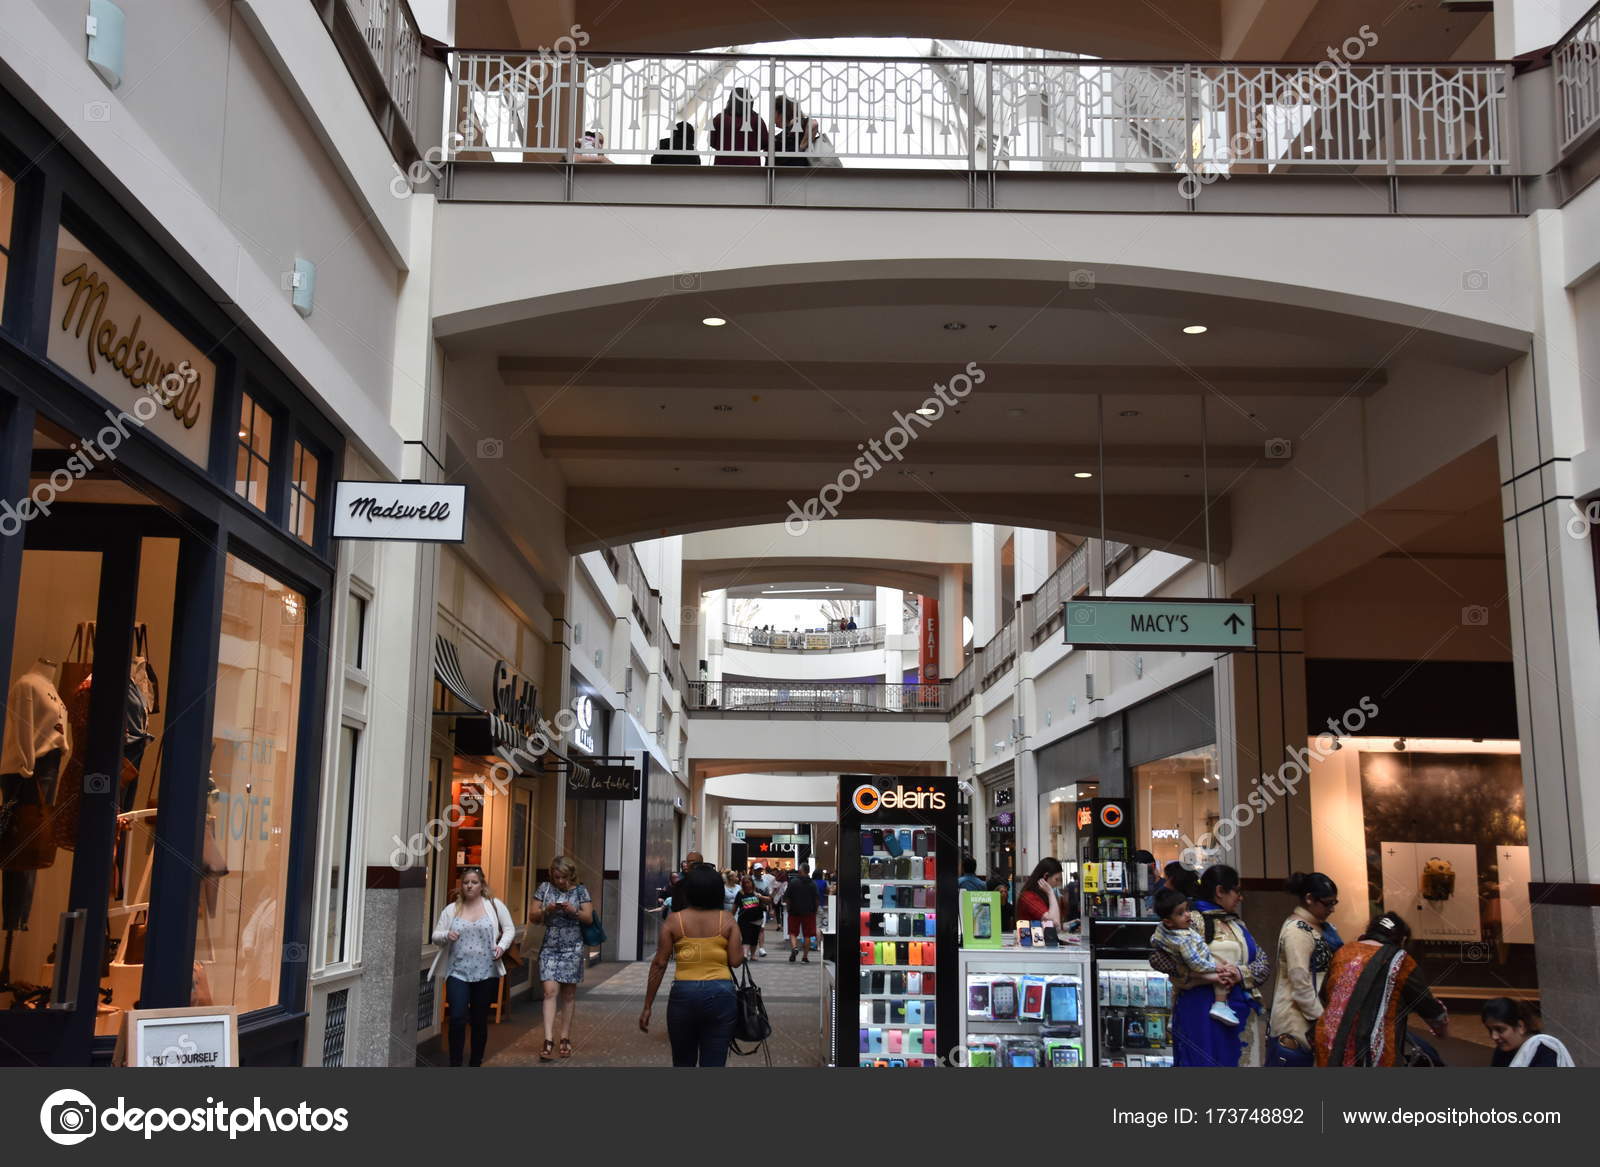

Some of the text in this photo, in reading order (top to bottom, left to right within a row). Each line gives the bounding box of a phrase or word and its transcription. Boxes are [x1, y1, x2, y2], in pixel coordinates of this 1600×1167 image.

[61, 262, 202, 429] Madewell
[349, 497, 450, 522] Madewell
[927, 617, 935, 658] EAT
[1130, 614, 1189, 632] MACY'S
[852, 784, 946, 814] Cellairis
[216, 791, 272, 841] TOTE
[176, 1052, 218, 1064] YOURSELF
